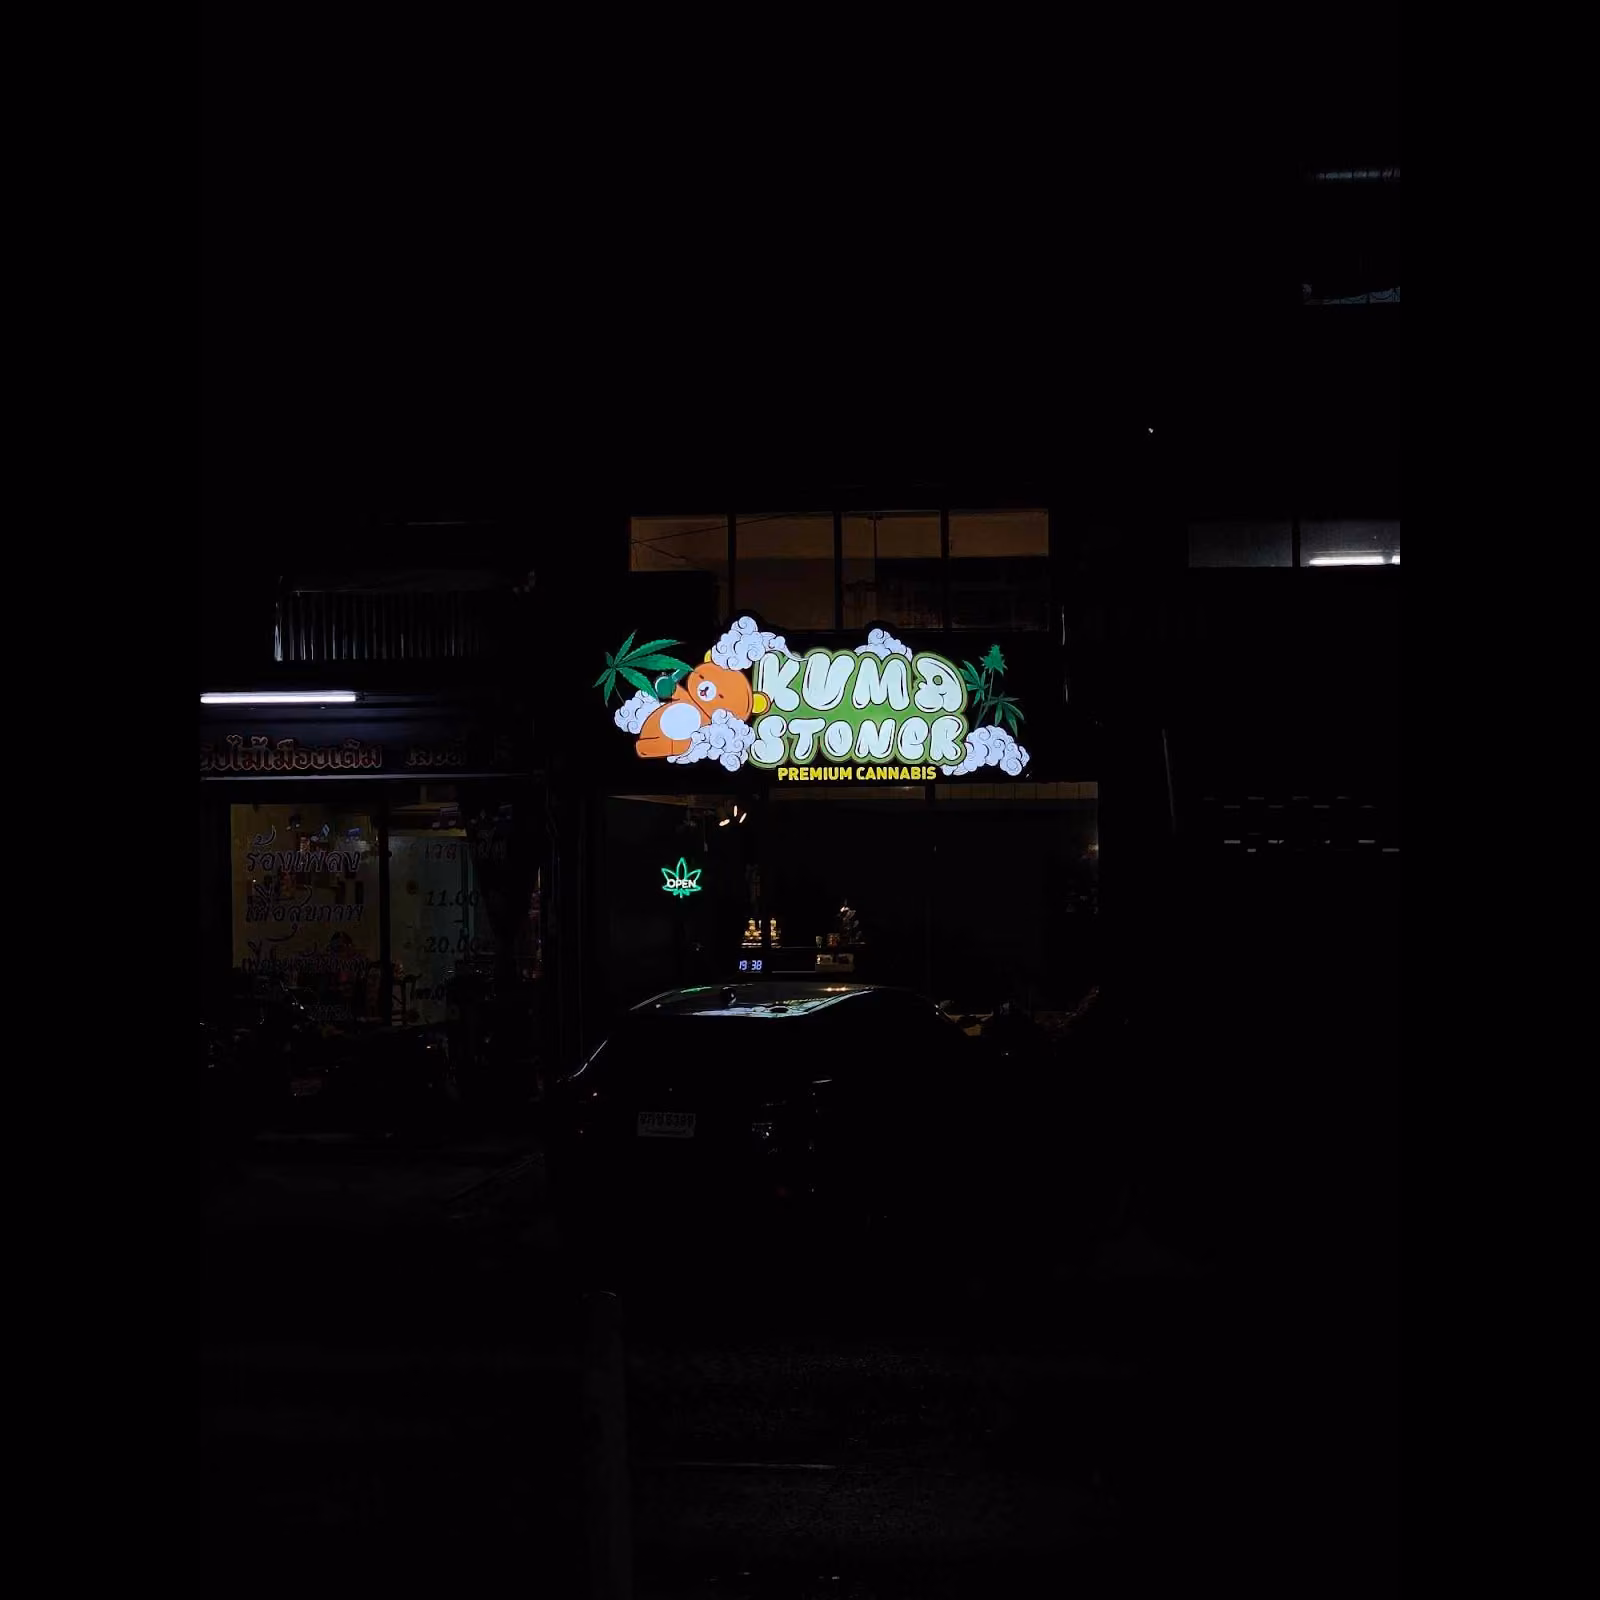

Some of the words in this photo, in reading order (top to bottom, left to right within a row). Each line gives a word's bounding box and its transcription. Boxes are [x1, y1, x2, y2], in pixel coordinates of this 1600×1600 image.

[758, 651, 964, 713] KUMA
[750, 713, 965, 765] STONER
[777, 766, 853, 782] PREMIUM
[855, 765, 937, 781] CANNABIS
[667, 878, 697, 889] OPEN
[426, 889, 479, 906] 11.00
